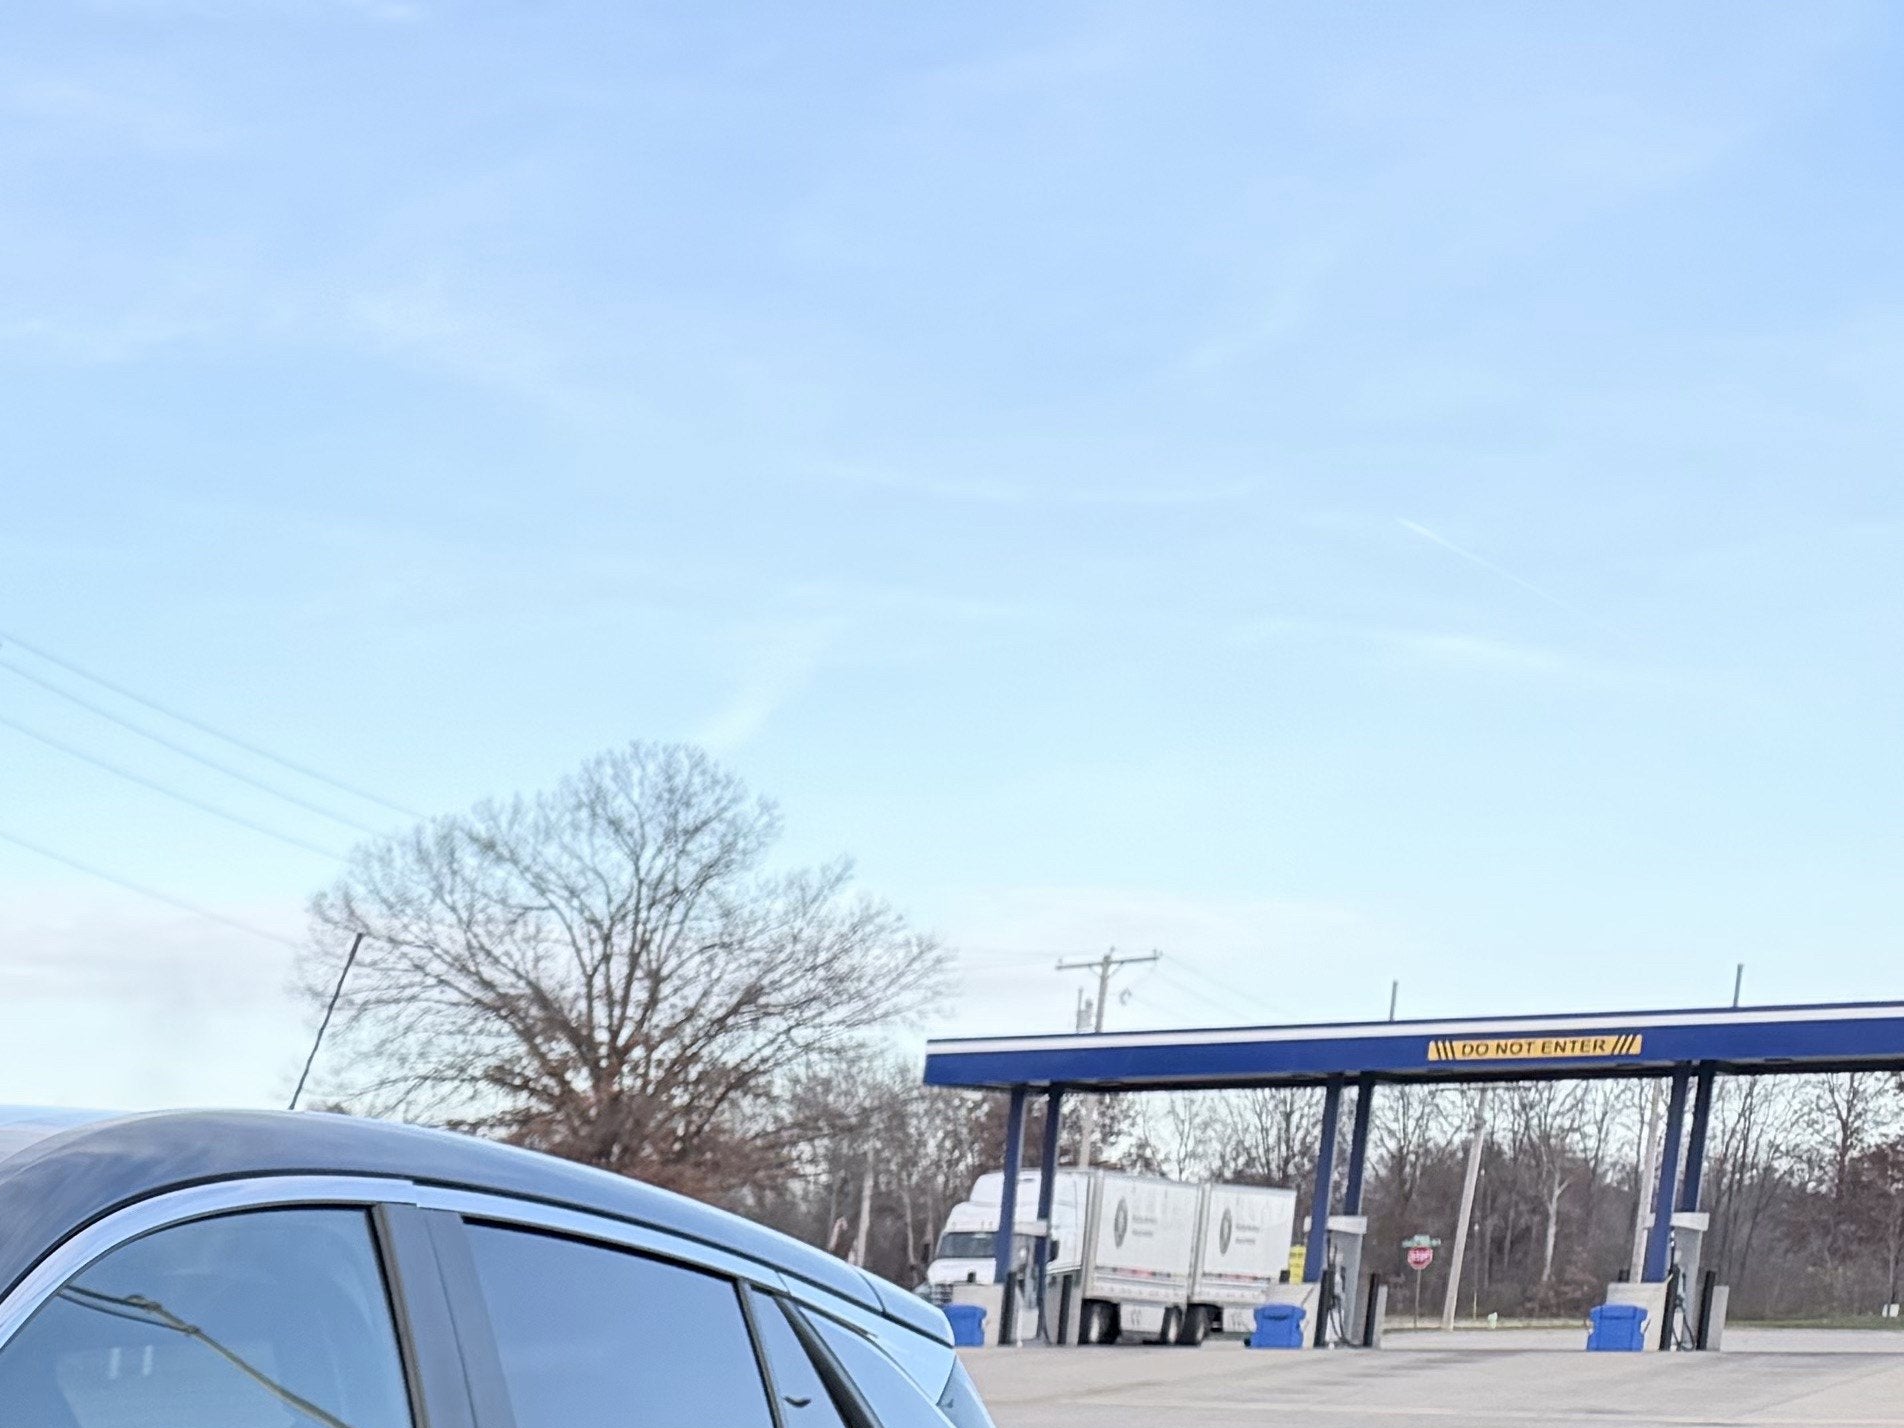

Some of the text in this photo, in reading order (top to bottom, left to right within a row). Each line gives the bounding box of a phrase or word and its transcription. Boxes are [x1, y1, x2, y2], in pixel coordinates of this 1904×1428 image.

[1461, 1038, 1606, 1057] DO NOT ENTER
